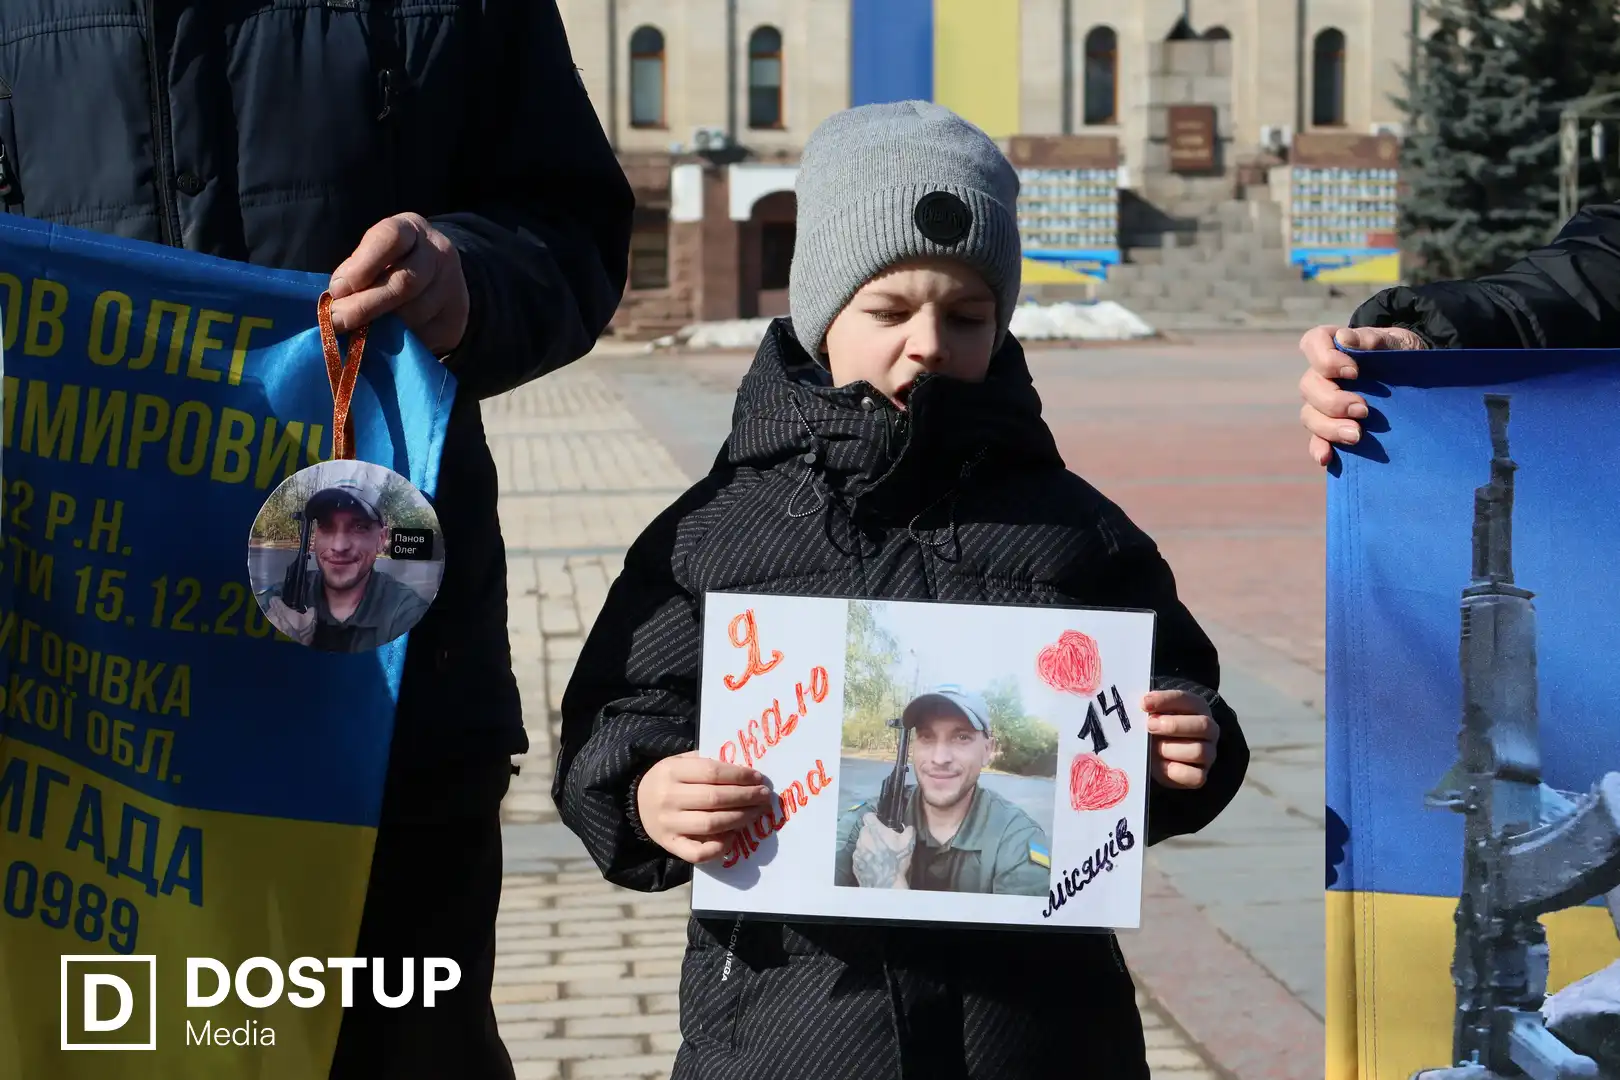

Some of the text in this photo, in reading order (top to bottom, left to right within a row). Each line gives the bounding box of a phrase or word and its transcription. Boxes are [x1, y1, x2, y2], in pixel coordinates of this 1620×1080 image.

[87, 290, 273, 386] ОЛЕГ
[45, 490, 132, 556] Р.Н.
[394, 545, 417, 554] Олег
[395, 533, 425, 543] Панов
[0, 533, 54, 602] ТИ
[723, 608, 784, 691] Я
[86, 708, 182, 783] ОБЛ.
[719, 666, 829, 768] екаю
[1077, 684, 1132, 755] 14
[1043, 817, 1135, 919] місяців
[4, 860, 139, 955] 0989
